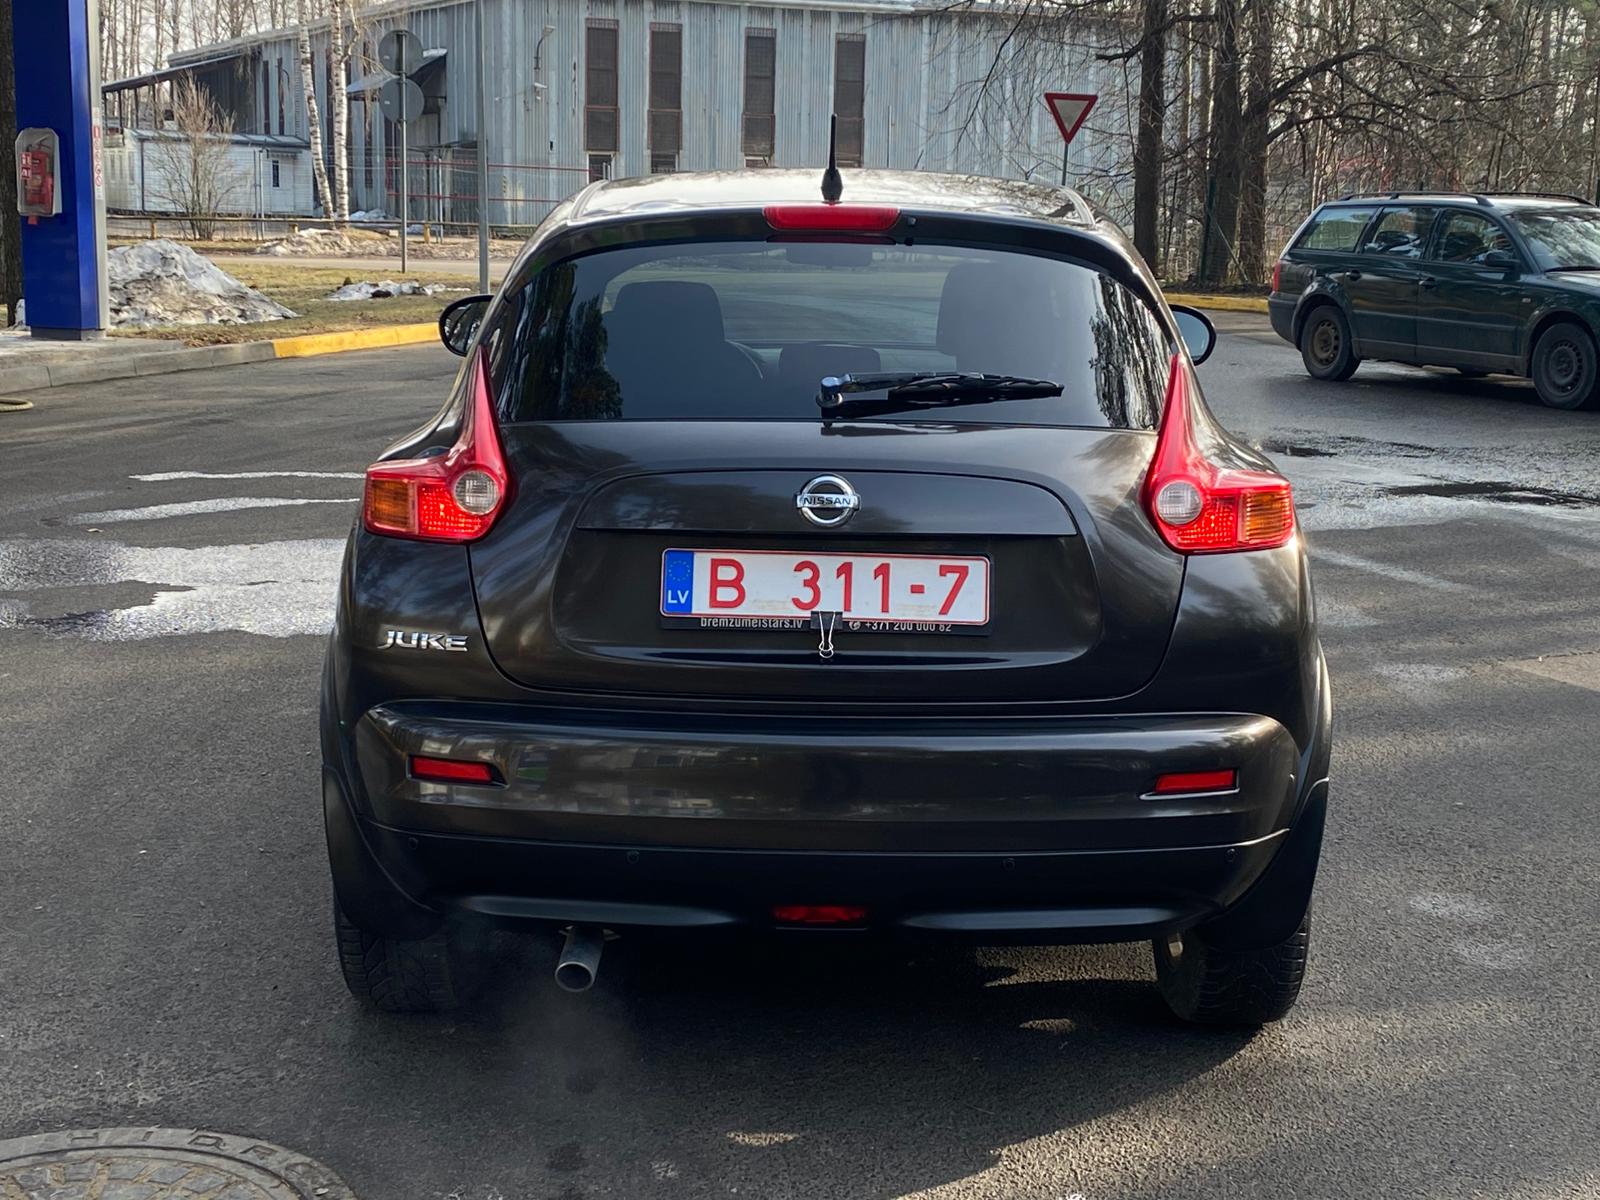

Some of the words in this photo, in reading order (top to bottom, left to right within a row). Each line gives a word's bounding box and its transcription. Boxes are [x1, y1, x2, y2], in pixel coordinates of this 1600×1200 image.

[803, 496, 851, 506] NISSAN
[708, 557, 746, 609] B
[791, 560, 969, 616] 311-7
[667, 589, 689, 605] LV
[377, 630, 469, 652] JUKE
